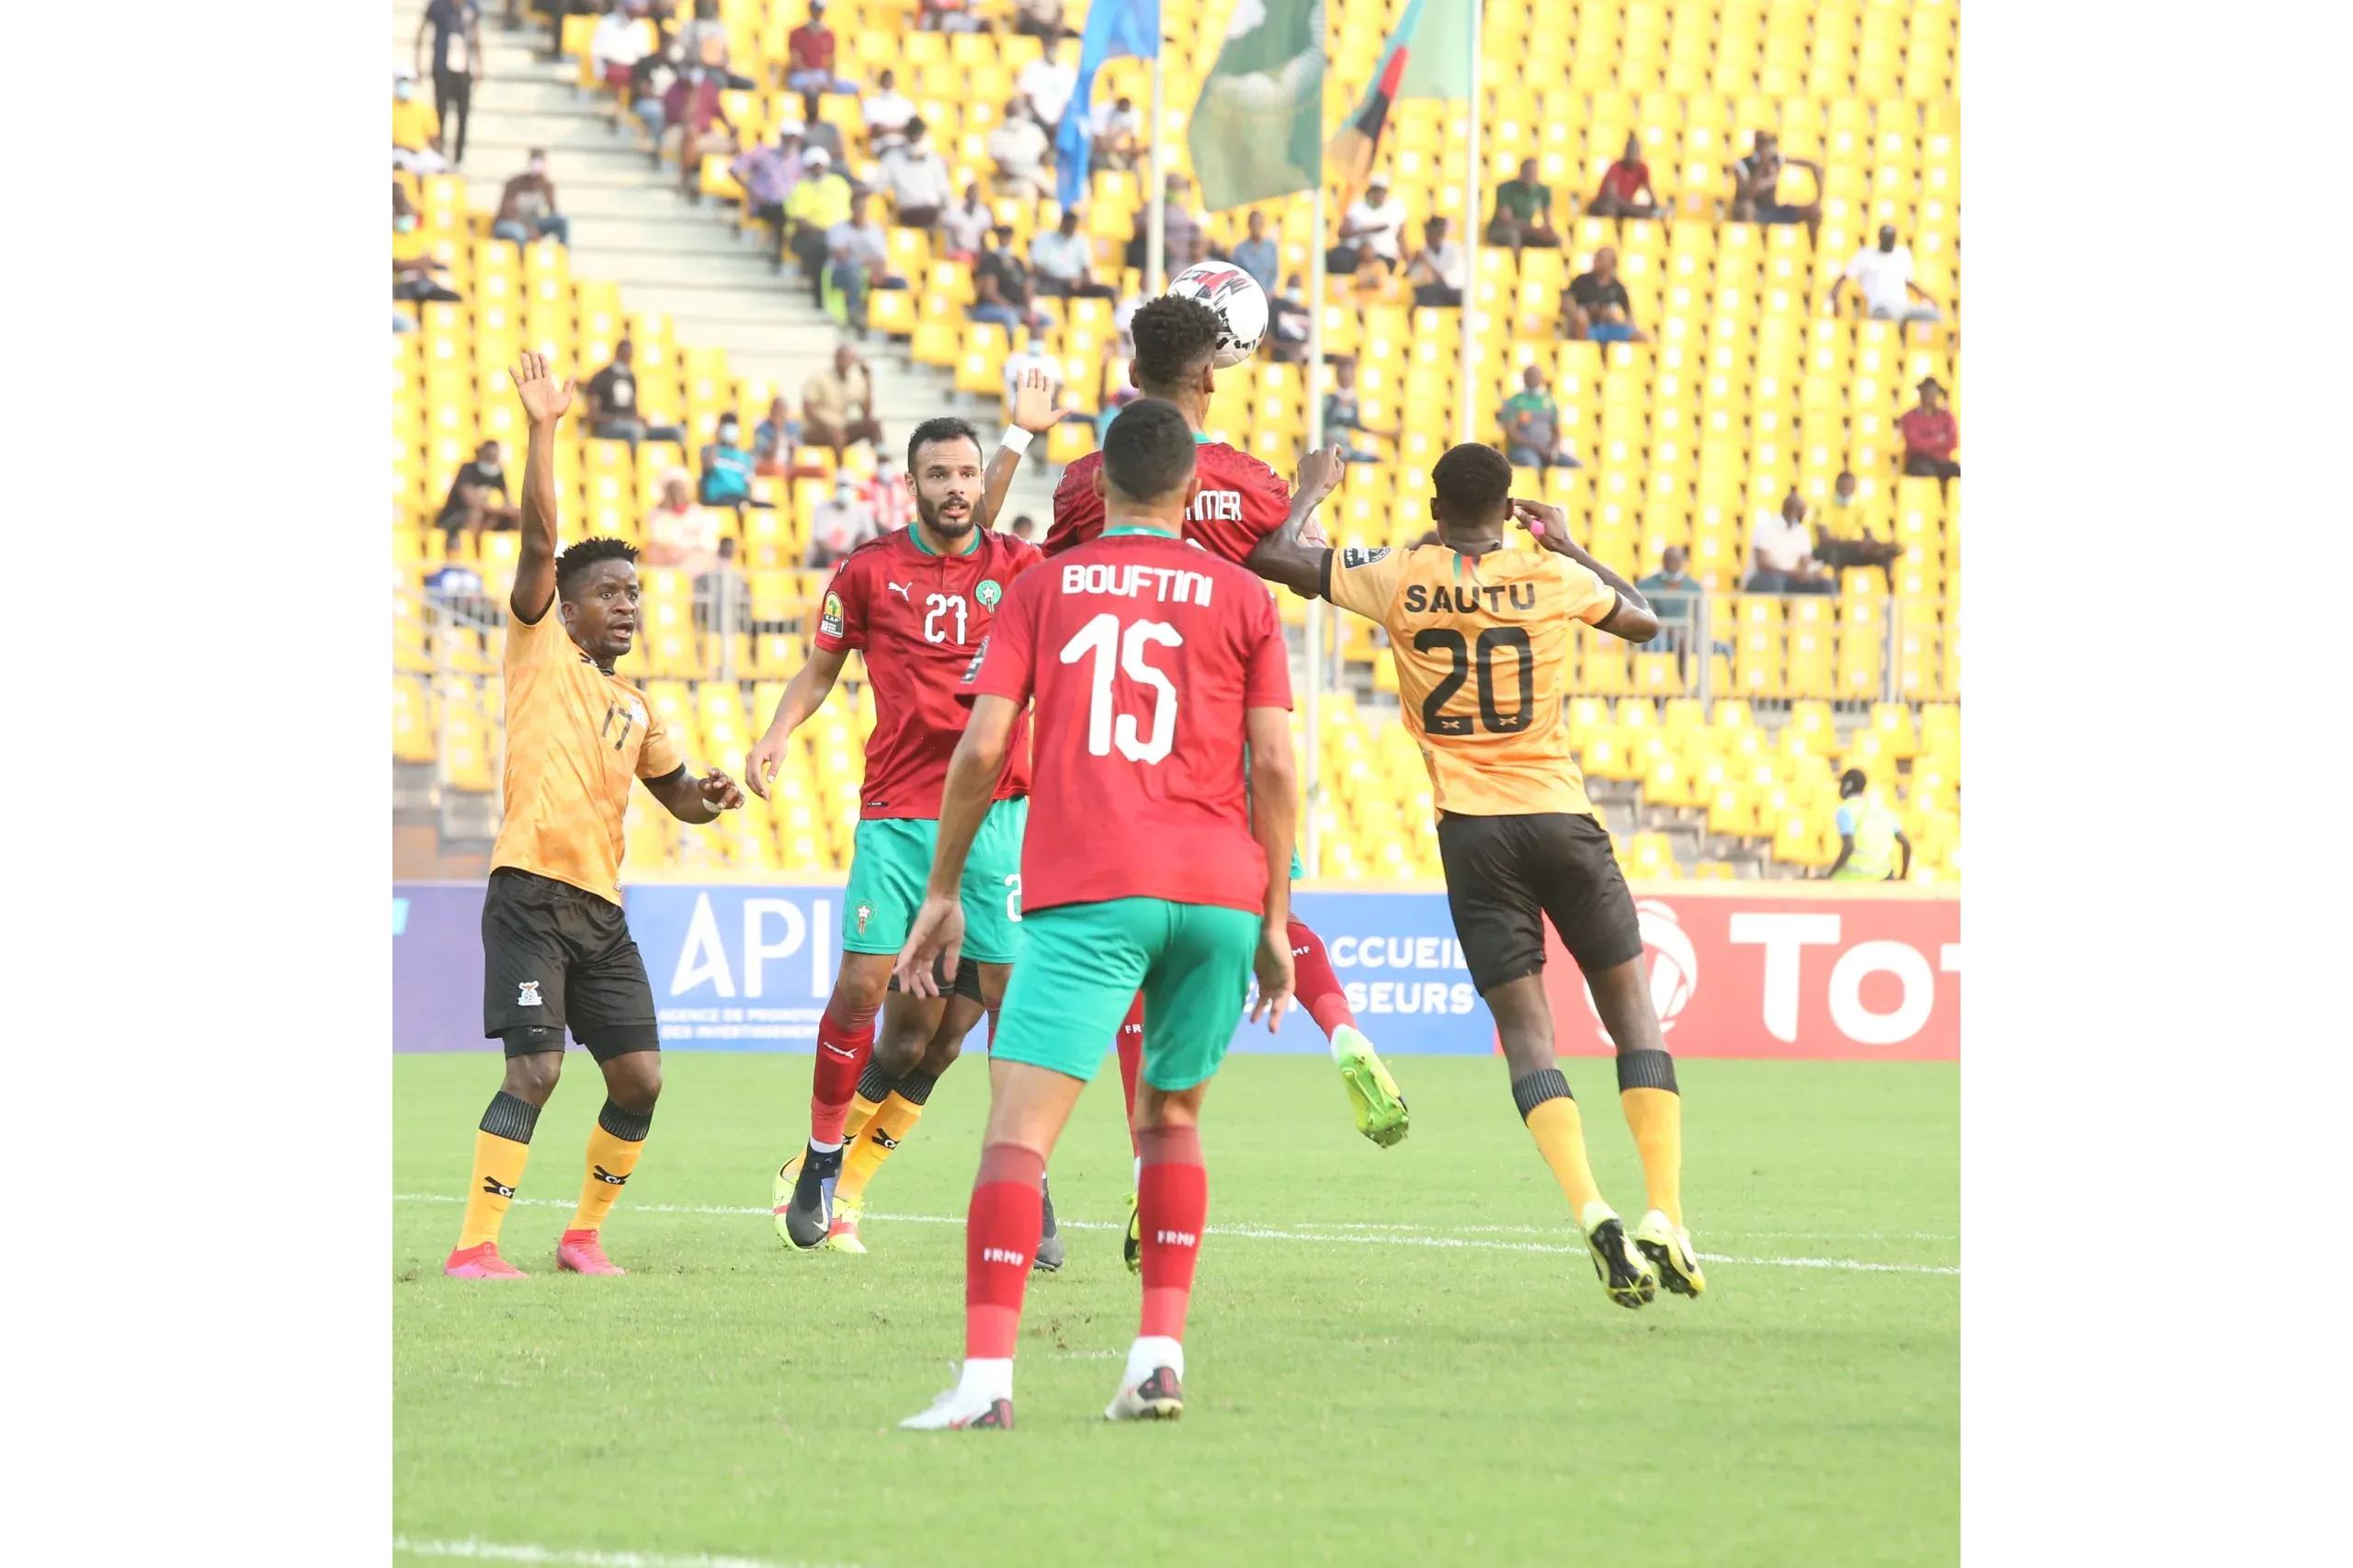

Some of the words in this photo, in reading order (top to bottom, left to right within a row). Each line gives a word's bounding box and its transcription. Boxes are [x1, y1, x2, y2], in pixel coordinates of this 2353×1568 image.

[1062, 563, 1213, 608] BOUFTINI
[1404, 583, 1536, 614] SAUTU
[925, 593, 968, 645] 27
[1060, 613, 1183, 765] 15
[1414, 626, 1534, 735] 20
[601, 699, 632, 750] 17
[669, 890, 832, 998] API
[1157, 1230, 1195, 1247] FRMF
